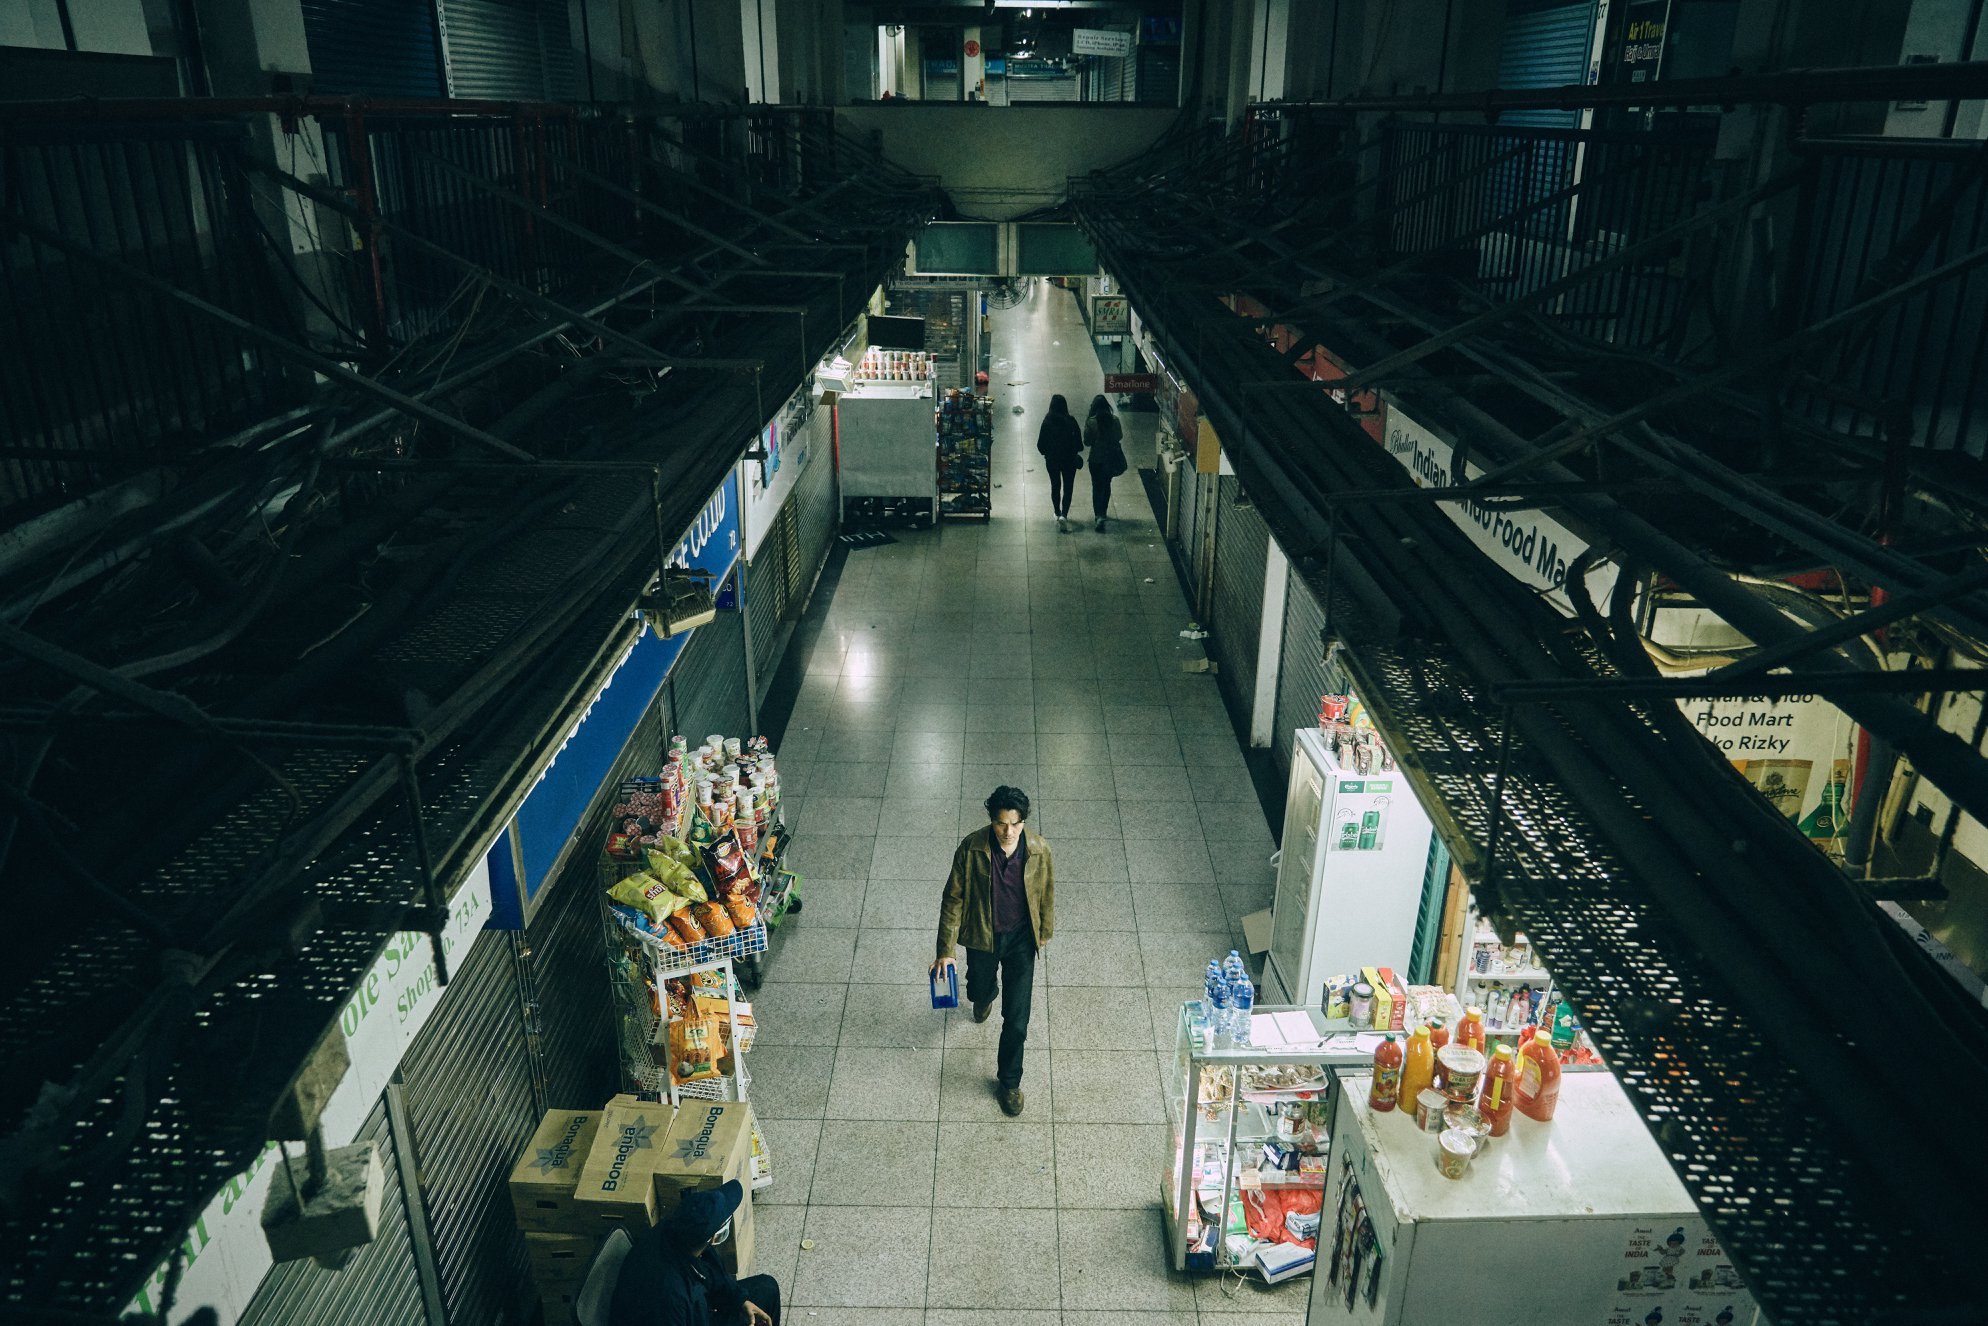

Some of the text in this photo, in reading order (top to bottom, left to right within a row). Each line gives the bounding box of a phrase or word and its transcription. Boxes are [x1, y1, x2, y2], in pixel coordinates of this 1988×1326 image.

[1645, 20, 1665, 39] Trave
[1412, 440, 1447, 488] Indian
[1493, 511, 1538, 566] Food
[1696, 712, 1794, 727] Food Mart
[1713, 735, 1790, 754] ko Rizky
[397, 964, 433, 1024] Shop
[551, 1115, 588, 1168] Bonaqua
[693, 1106, 724, 1158] Bonaqua
[601, 1127, 636, 1192] Bonaqua
[1625, 1250, 1649, 1258] INDIA
[1697, 1248, 1721, 1256] INDIA
